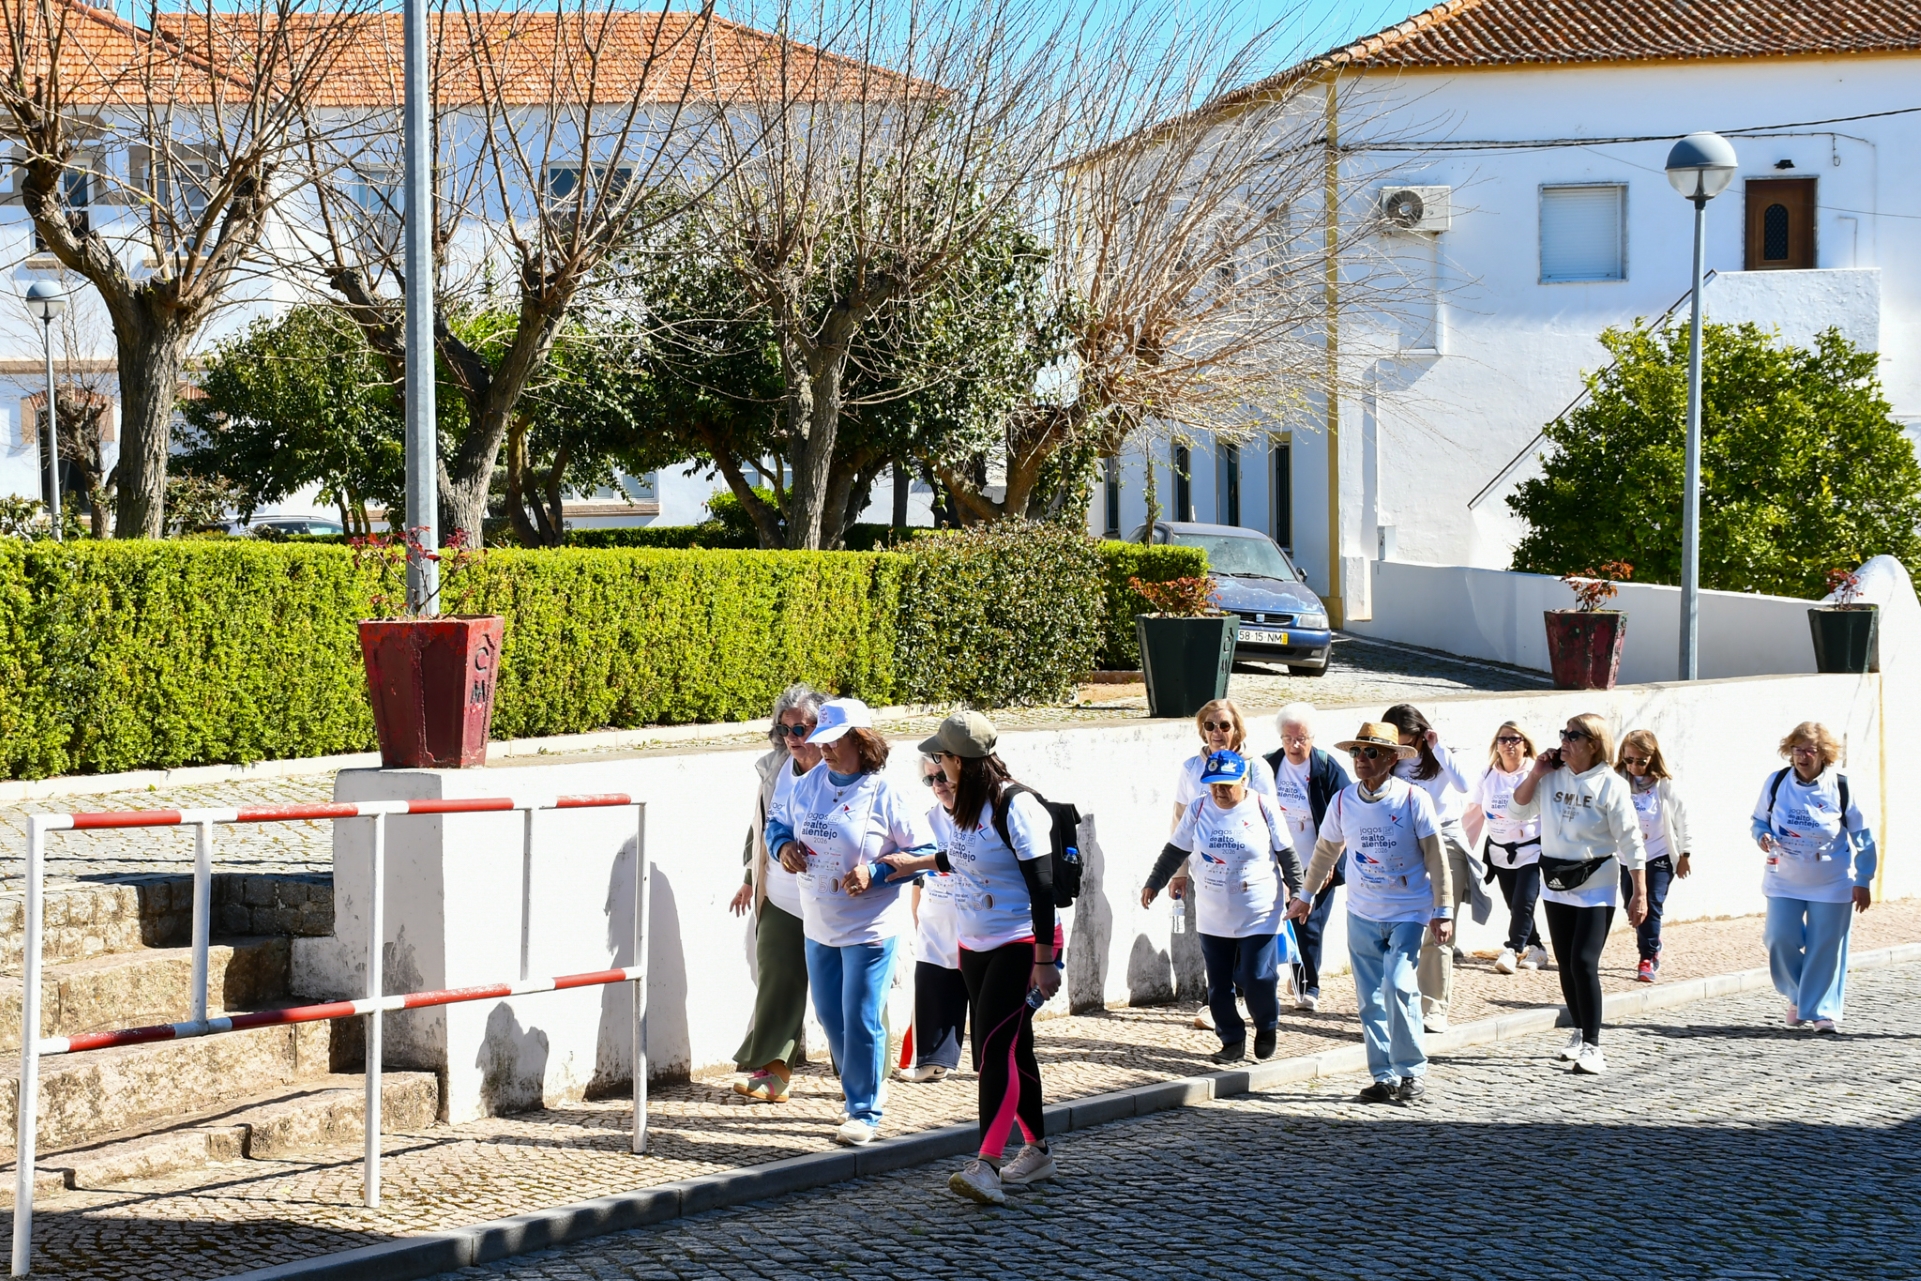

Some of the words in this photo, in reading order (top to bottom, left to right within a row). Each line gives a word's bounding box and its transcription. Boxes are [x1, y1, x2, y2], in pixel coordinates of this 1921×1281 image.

[1276, 792, 1306, 800] alentejo
[1553, 791, 1592, 809] SMLE
[806, 810, 828, 820] jogos
[810, 820, 828, 829] alto
[1787, 819, 1820, 828] alentejo
[802, 828, 838, 840] alentejo
[1360, 826, 1382, 835] jogos
[1209, 842, 1245, 850] alentejo
[1362, 840, 1397, 848] alentejo
[818, 875, 840, 895] 50
